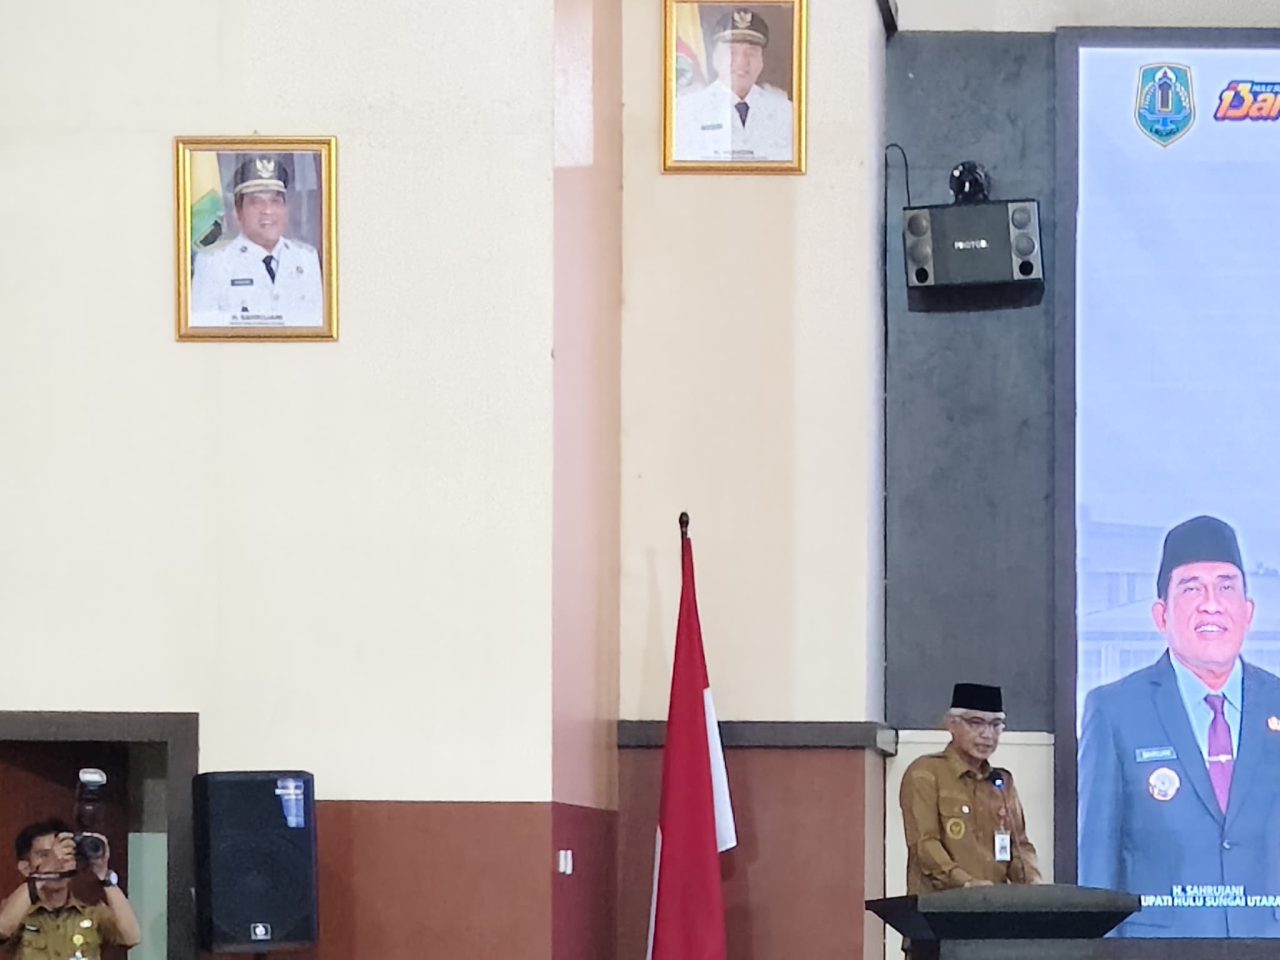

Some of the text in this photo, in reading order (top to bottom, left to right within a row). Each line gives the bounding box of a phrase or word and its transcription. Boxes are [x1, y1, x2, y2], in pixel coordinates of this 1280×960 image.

[1172, 885, 1185, 896] H.
[1140, 895, 1173, 907] UPATI
[1174, 895, 1204, 907] HULU
[1205, 895, 1246, 907] SUNGAI
